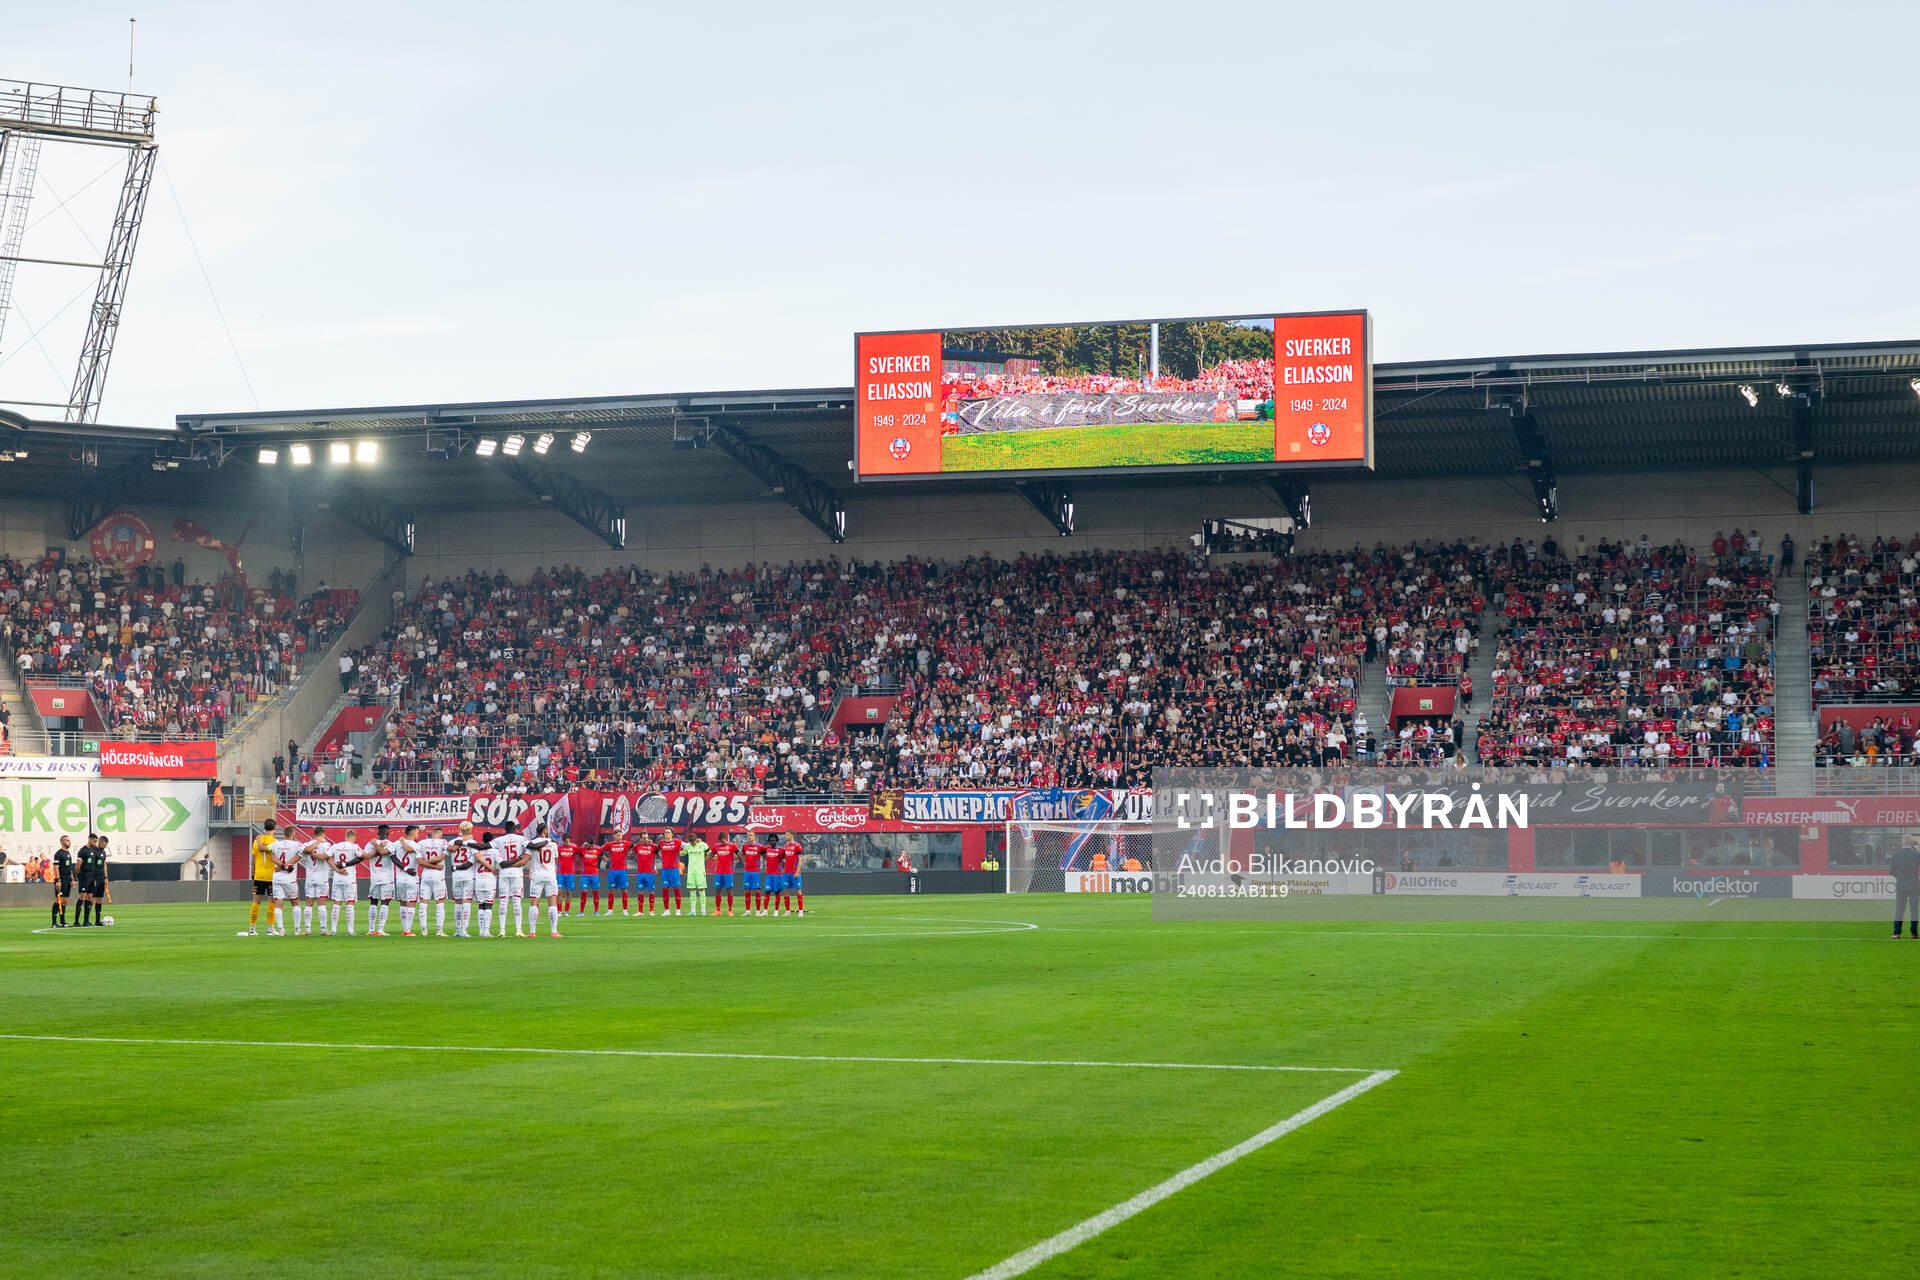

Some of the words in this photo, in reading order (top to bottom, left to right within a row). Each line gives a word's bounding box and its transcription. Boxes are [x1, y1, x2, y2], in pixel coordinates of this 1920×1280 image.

[1285, 337, 1351, 357] SVERKER
[869, 355, 931, 374] SVERKER
[1284, 365, 1353, 385] ELIASSON
[867, 382, 932, 401] ELIASSON
[1290, 399, 1313, 412] 1949
[1322, 397, 1347, 411] 2024
[873, 415, 894, 427] 1949
[902, 413, 927, 426] 2024
[0, 762, 43, 772] PANS
[47, 762, 87, 772] BUSS
[101, 750, 184, 768] HÖGERSVÄNGEN
[300, 799, 384, 815] AVSTÄNGDA
[413, 799, 468, 814] HIF:ARE
[1571, 785, 1702, 813] Sverker
[671, 795, 748, 824] 1985
[748, 808, 783, 824] lsberg
[815, 807, 866, 825] Carlsberg
[117, 845, 164, 855] ELEDA
[454, 847, 468, 864] 23
[504, 845, 517, 861] 15
[538, 849, 552, 864] 10
[1079, 873, 1185, 894] tillmobil
[1399, 876, 1458, 888] AllOffice
[1517, 882, 1559, 890] BOLAGET
[1673, 876, 1760, 893] kondektor
